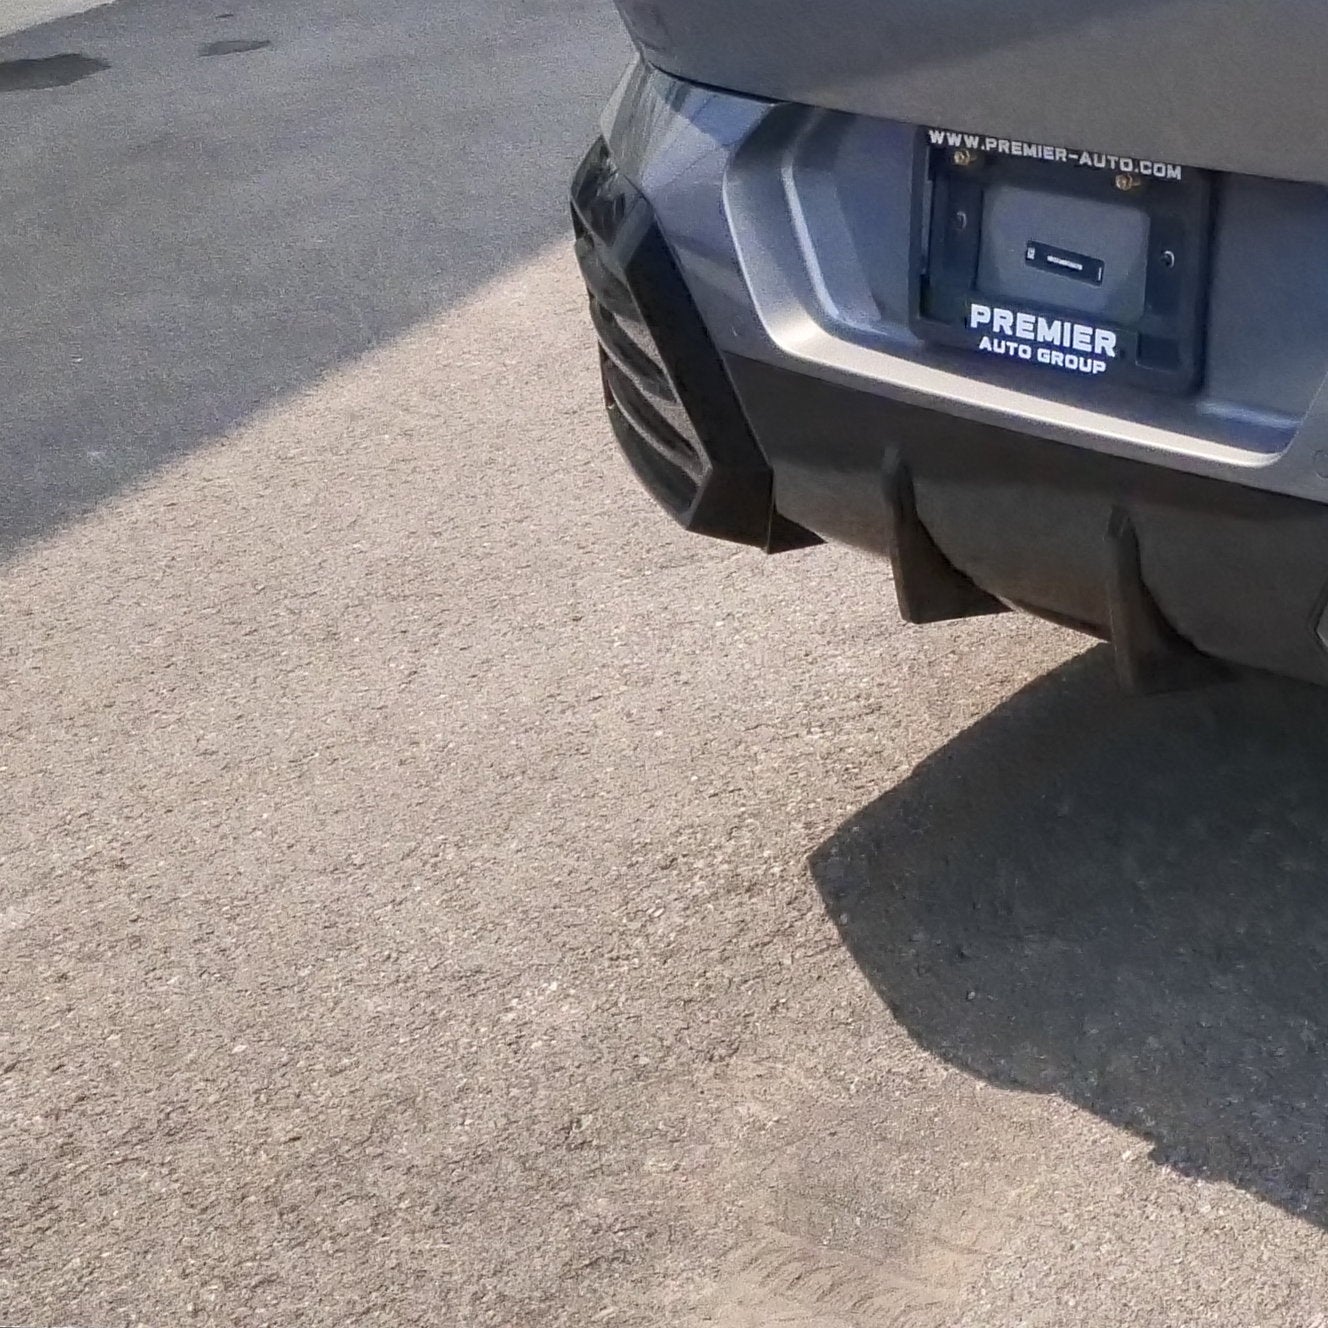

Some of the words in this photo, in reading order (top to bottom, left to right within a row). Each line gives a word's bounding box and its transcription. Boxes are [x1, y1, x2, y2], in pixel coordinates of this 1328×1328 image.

[928, 129, 1182, 180] WWW.PREMIER-AUTO.COM
[970, 303, 1117, 357] PREMIER
[978, 336, 1032, 360] AUTO
[1036, 347, 1107, 374] GROUP
